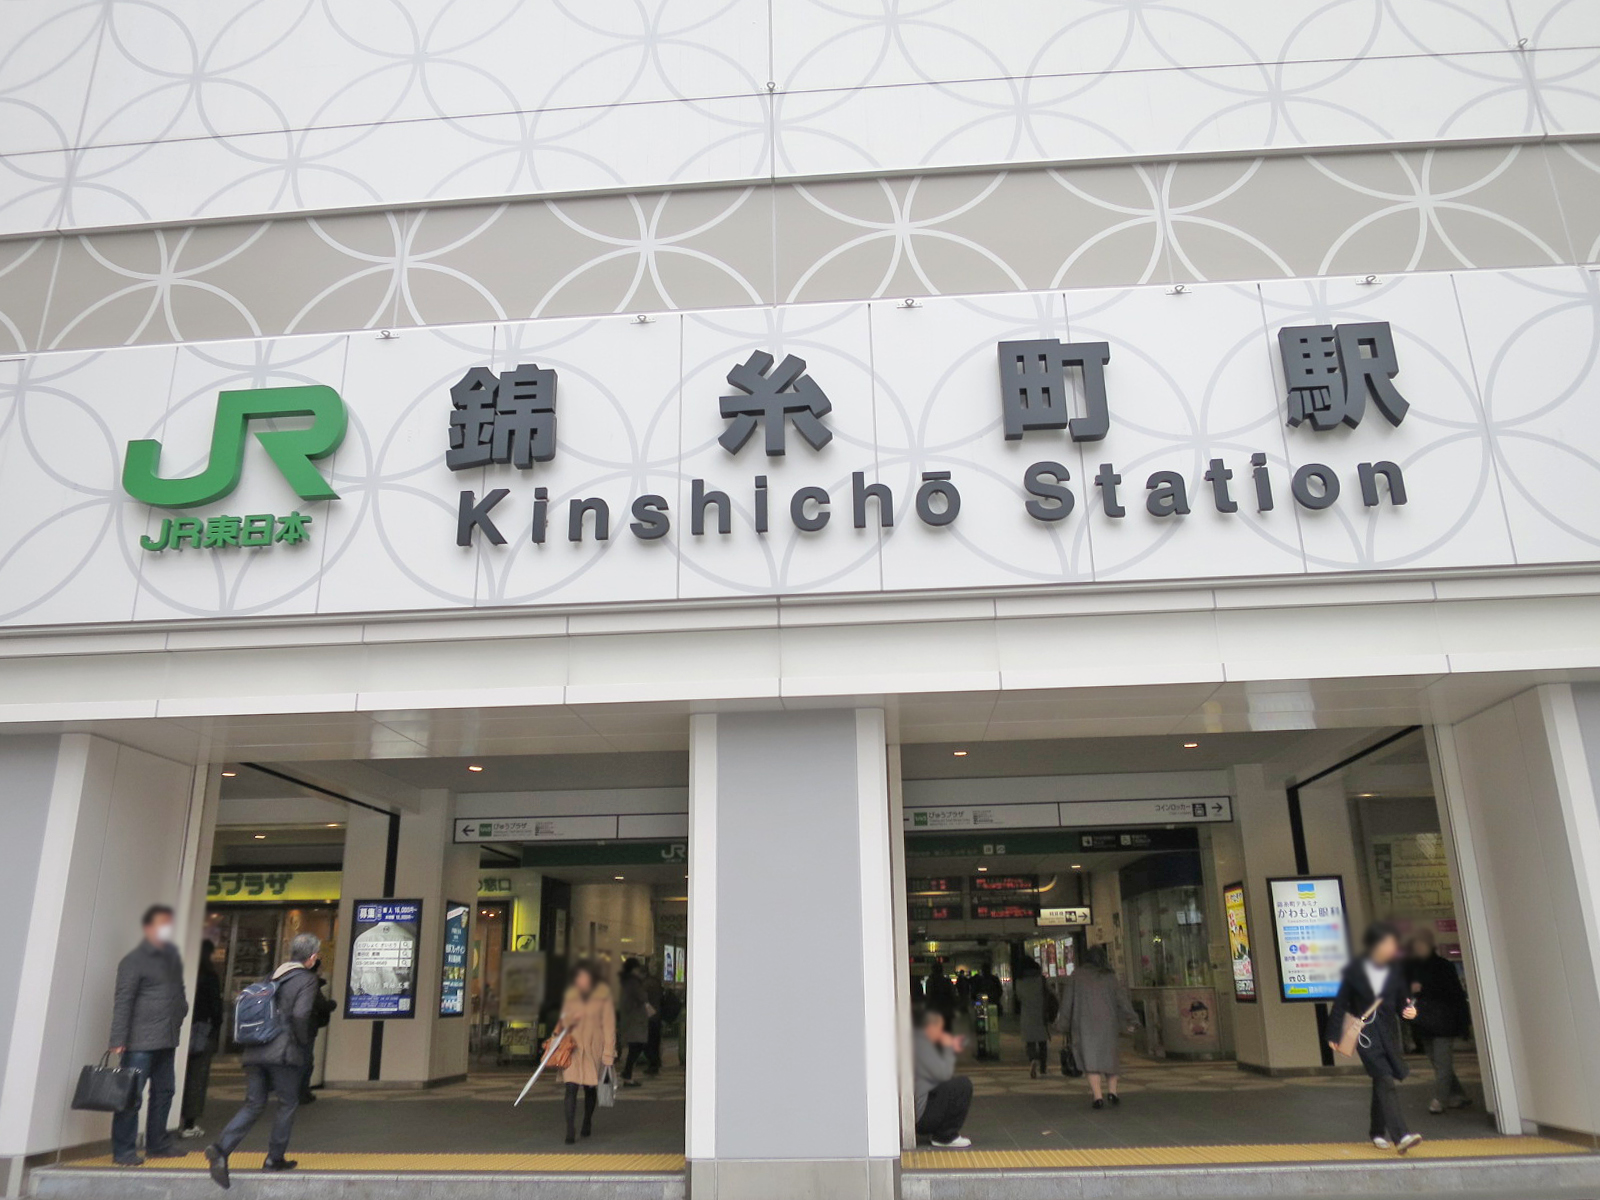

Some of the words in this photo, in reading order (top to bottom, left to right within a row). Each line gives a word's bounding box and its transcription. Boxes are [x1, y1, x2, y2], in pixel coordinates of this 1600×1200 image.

[446, 322, 1410, 471] 錦糸町駅
[122, 385, 348, 508] JR
[456, 471, 961, 548] Kinshichō
[1024, 453, 1407, 522] Station
[140, 510, 312, 553] JR東日本
[928, 810, 965, 819] びゅうプラザ
[1155, 803, 1192, 812] コインロッカー
[493, 822, 528, 831] びゅうプラザ
[661, 844, 686, 859] JR
